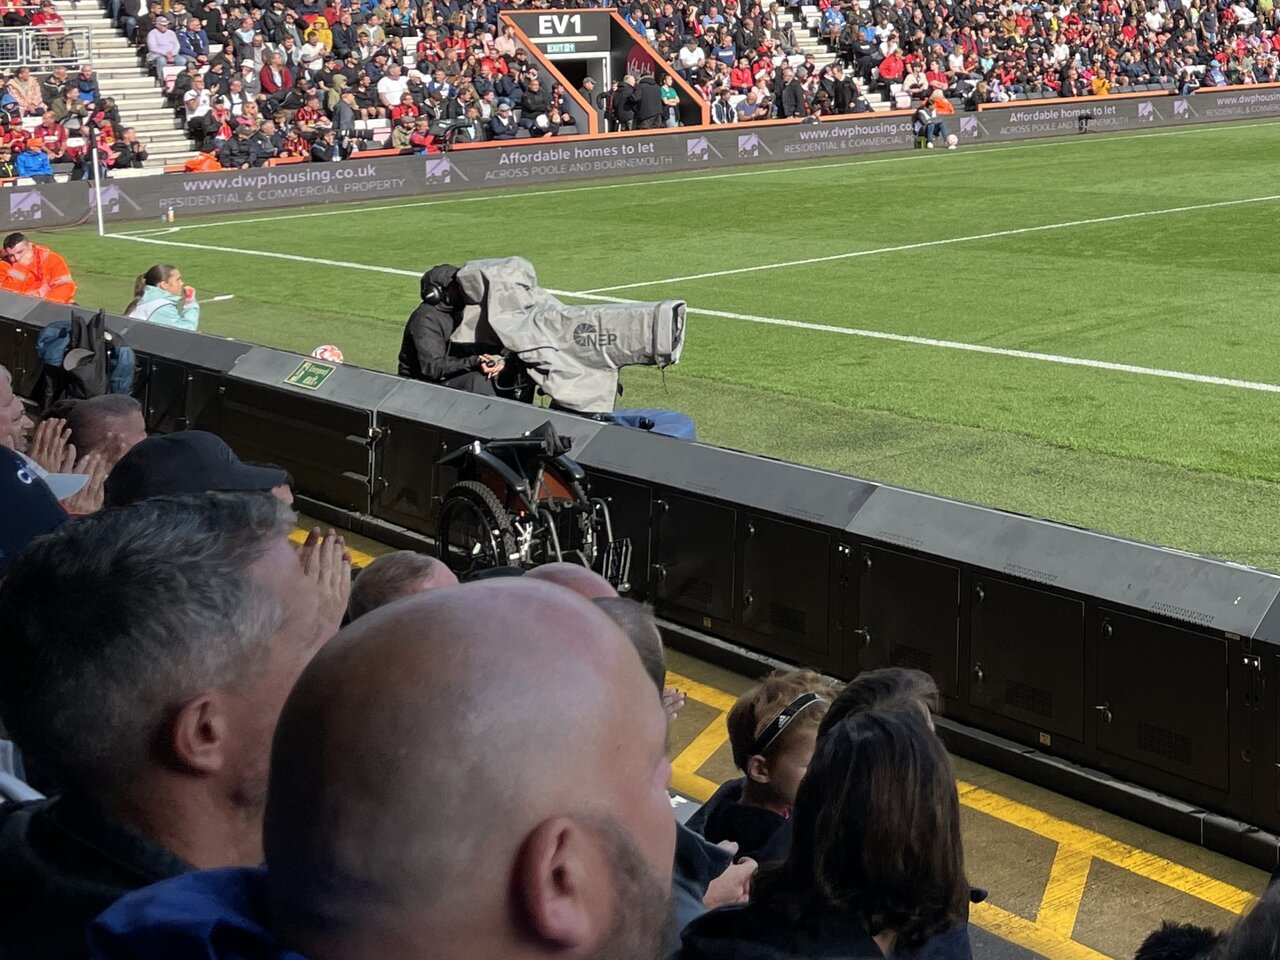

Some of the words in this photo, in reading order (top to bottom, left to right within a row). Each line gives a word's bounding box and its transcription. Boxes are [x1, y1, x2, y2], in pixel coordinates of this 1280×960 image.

[538, 14, 581, 34] EV1
[1010, 110, 1059, 122] Affordable
[1061, 108, 1091, 118] homes
[1104, 105, 1116, 114] let
[1000, 123, 1030, 135] ACROSS
[1032, 121, 1057, 132] POOLE
[1057, 120, 1073, 129] AND
[499, 149, 570, 165] Affordable
[574, 147, 618, 159] homes
[622, 144, 635, 155] to
[638, 142, 654, 153] let
[784, 141, 838, 153] RESIDENTIAL
[841, 140, 846, 149] &
[849, 136, 907, 150] COMMERCIAL
[184, 164, 376, 191] www.dwphousing.co.uk
[485, 168, 528, 180] ACROSS
[531, 165, 567, 177] POOLE
[569, 162, 592, 173] AND
[595, 155, 672, 171] BOURNEMOUTH
[159, 192, 242, 209] RESIDENTIAL
[245, 192, 254, 202] &
[258, 185, 340, 201] COMMERCIAL
[344, 178, 406, 193] PROPERTY
[587, 334, 617, 346] NEP
